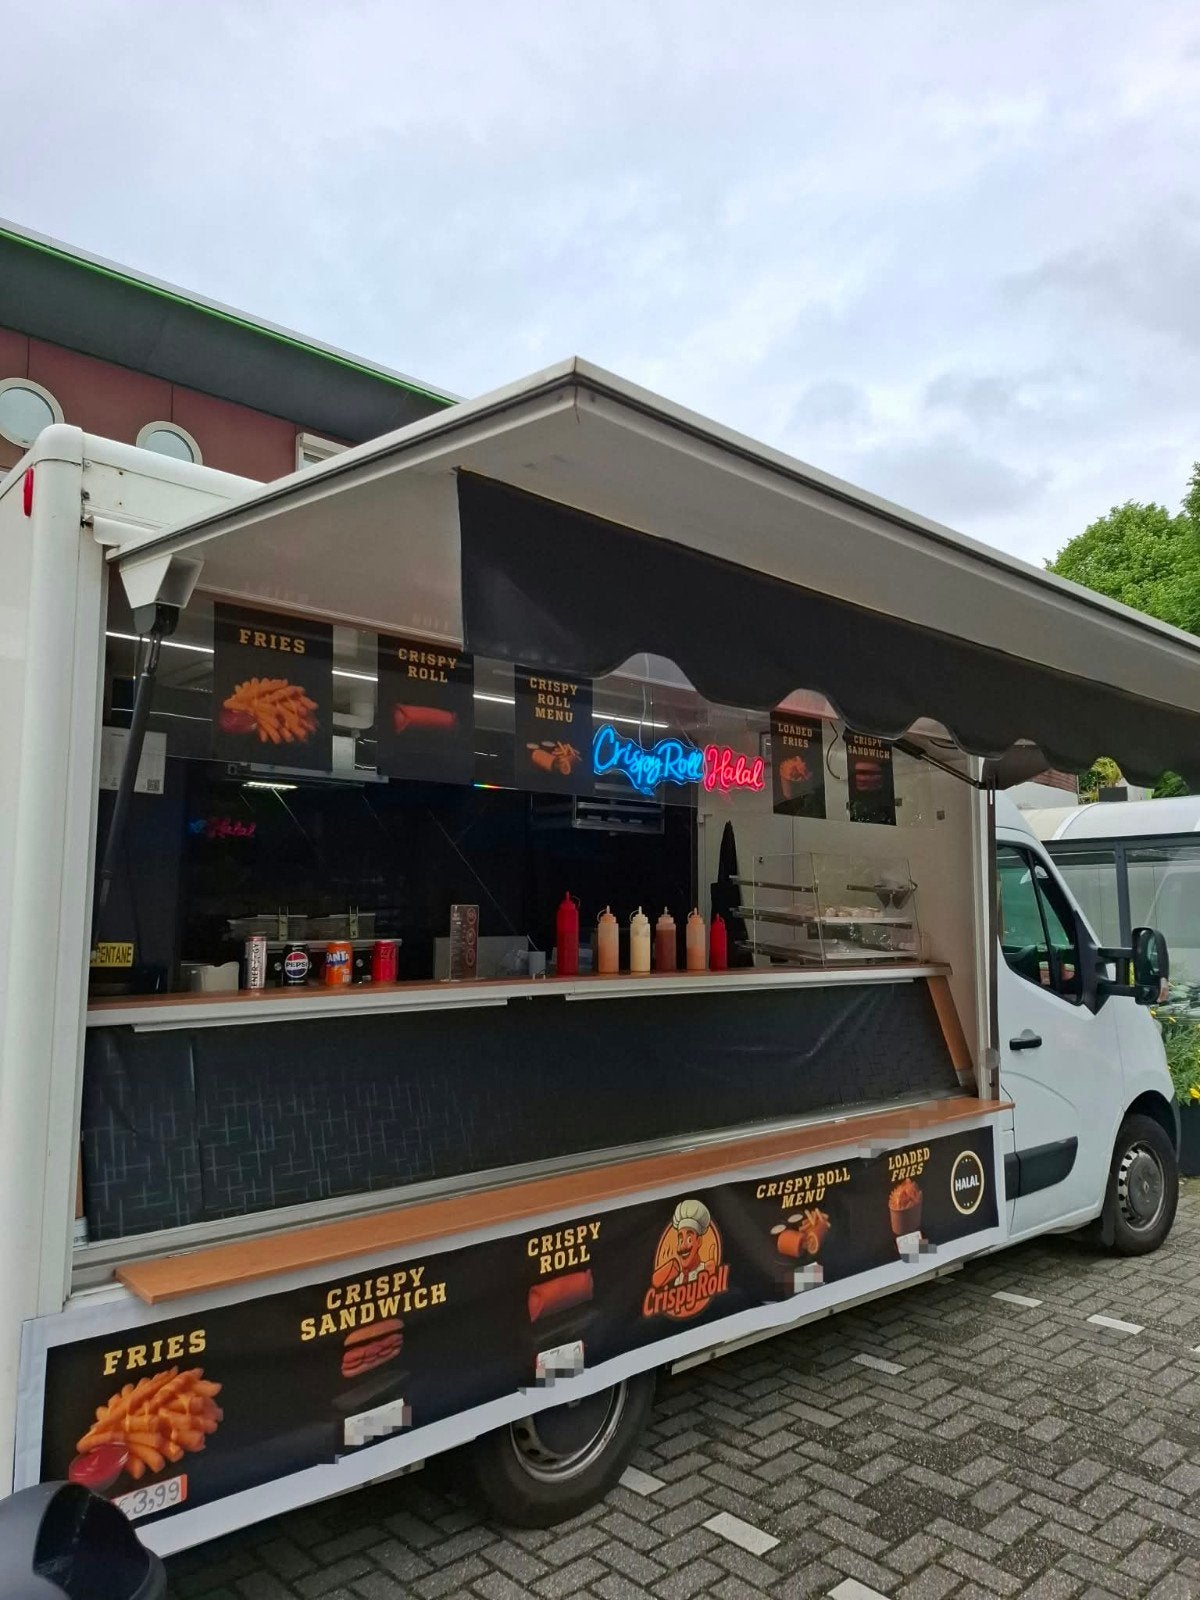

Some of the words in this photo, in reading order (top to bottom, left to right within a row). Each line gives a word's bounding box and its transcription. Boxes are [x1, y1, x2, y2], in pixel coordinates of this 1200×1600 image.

[239, 629, 306, 654] FRIES
[398, 648, 457, 669] CRISPY
[408, 664, 448, 683] ROLL
[530, 677, 579, 696] CRISPY
[537, 693, 571, 709] ROLL
[535, 706, 574, 724] MENU
[778, 722, 813, 738] LOADED
[783, 735, 809, 749] FRIES
[853, 735, 882, 748] CRISPY
[594, 724, 661, 787] Crispy
[662, 743, 703, 778] Roll
[705, 745, 764, 790] Halal
[848, 745, 890, 760] SANDWICH
[888, 1147, 930, 1170] LOADED
[891, 1162, 923, 1182] FRIES
[756, 1175, 815, 1200] CRISPY
[816, 1168, 850, 1188] ROLL
[955, 1174, 980, 1192] HALAL
[781, 1187, 826, 1210] MENU
[527, 1221, 601, 1257] CRISPY
[540, 1245, 590, 1275] ROLL
[326, 1267, 425, 1310] CRISPY
[300, 1282, 448, 1342] SANDWICH
[102, 1329, 208, 1376] FRIES
